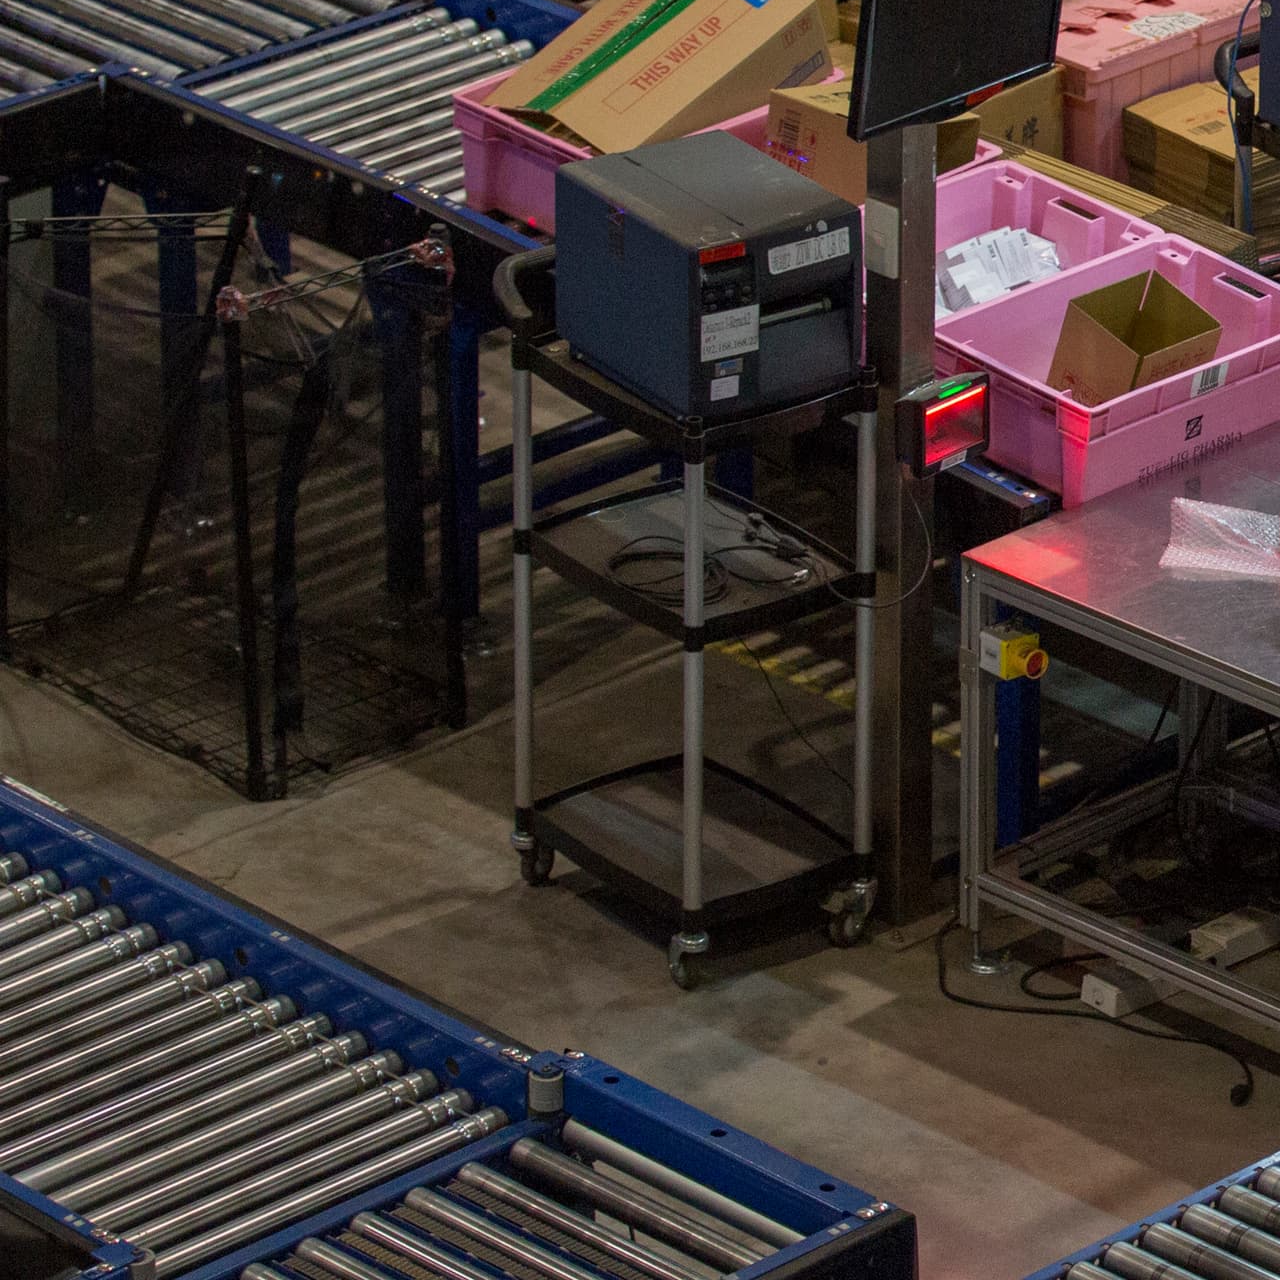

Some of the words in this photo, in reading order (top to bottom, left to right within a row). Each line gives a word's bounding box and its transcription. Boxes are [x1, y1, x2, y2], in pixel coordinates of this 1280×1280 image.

[630, 61, 672, 91] THIS
[668, 34, 703, 65] WAY
[698, 16, 723, 38] UP
